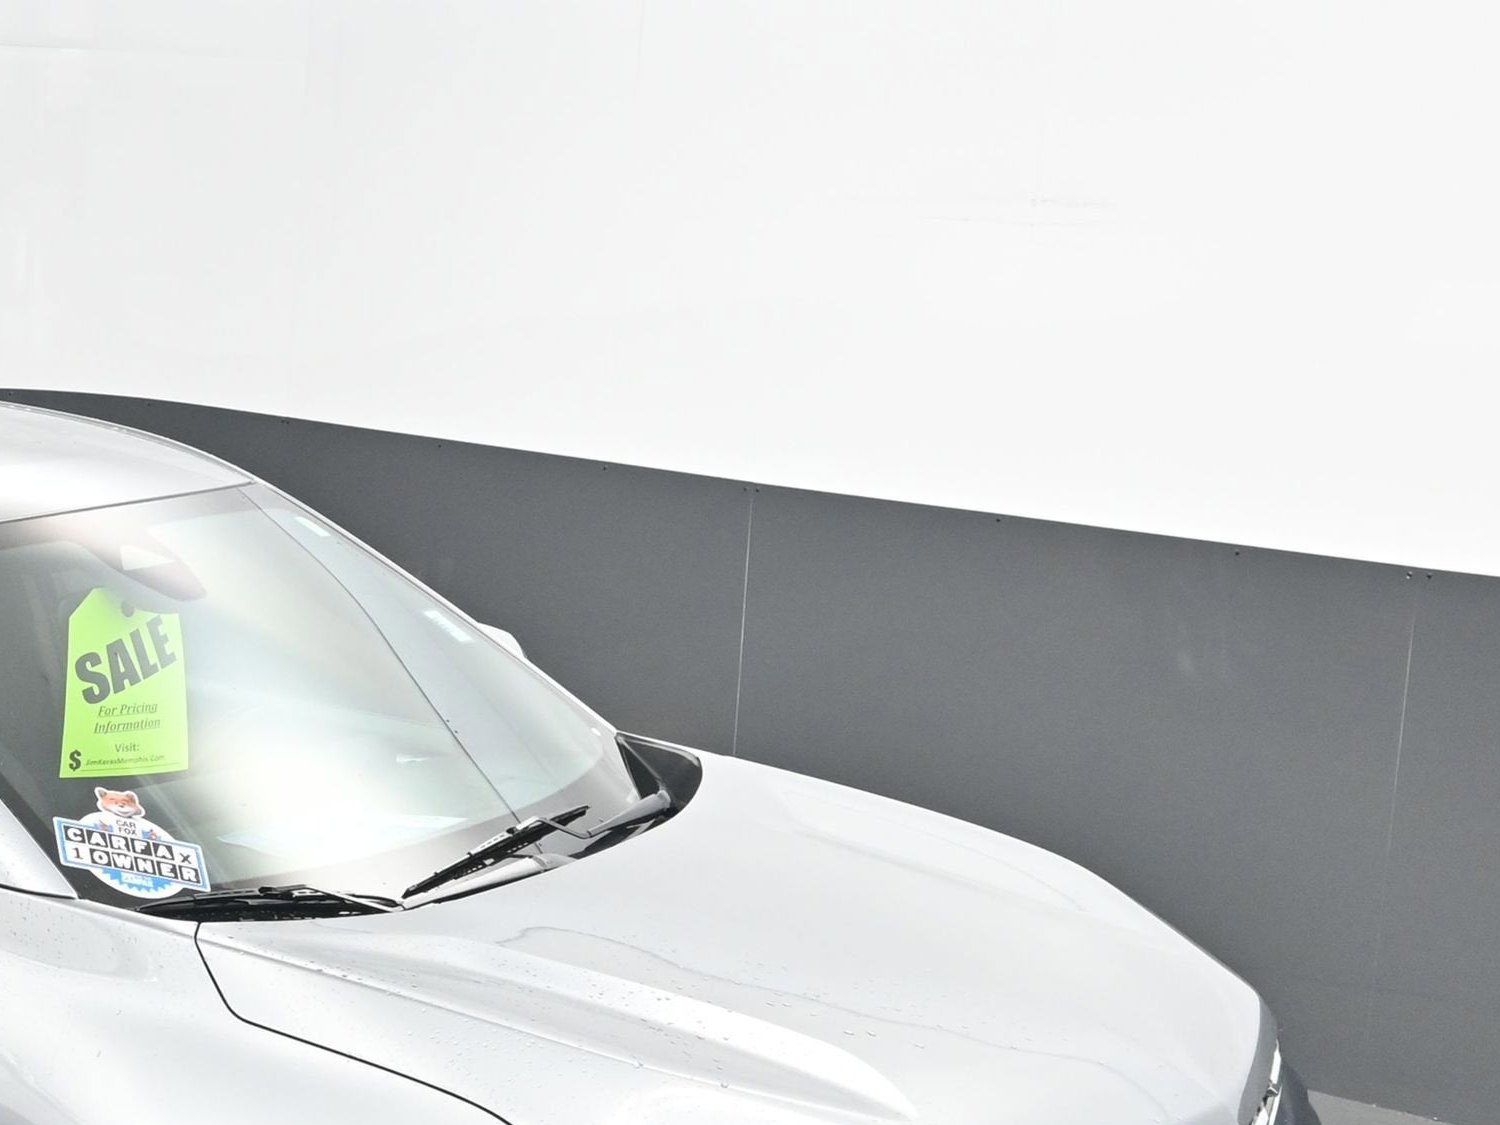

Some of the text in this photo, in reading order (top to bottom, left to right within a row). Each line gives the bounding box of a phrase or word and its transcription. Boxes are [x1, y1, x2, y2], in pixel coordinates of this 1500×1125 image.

[75, 615, 177, 704] SALE
[98, 702, 157, 717] For Pricing
[94, 719, 160, 734] Information
[115, 742, 140, 753] Visit:
[69, 749, 82, 771] $
[116, 819, 136, 829] CAR
[118, 827, 138, 836] FOX
[65, 826, 193, 865] CARFAX
[73, 847, 84, 860] 1
[92, 850, 199, 883] OWNER
